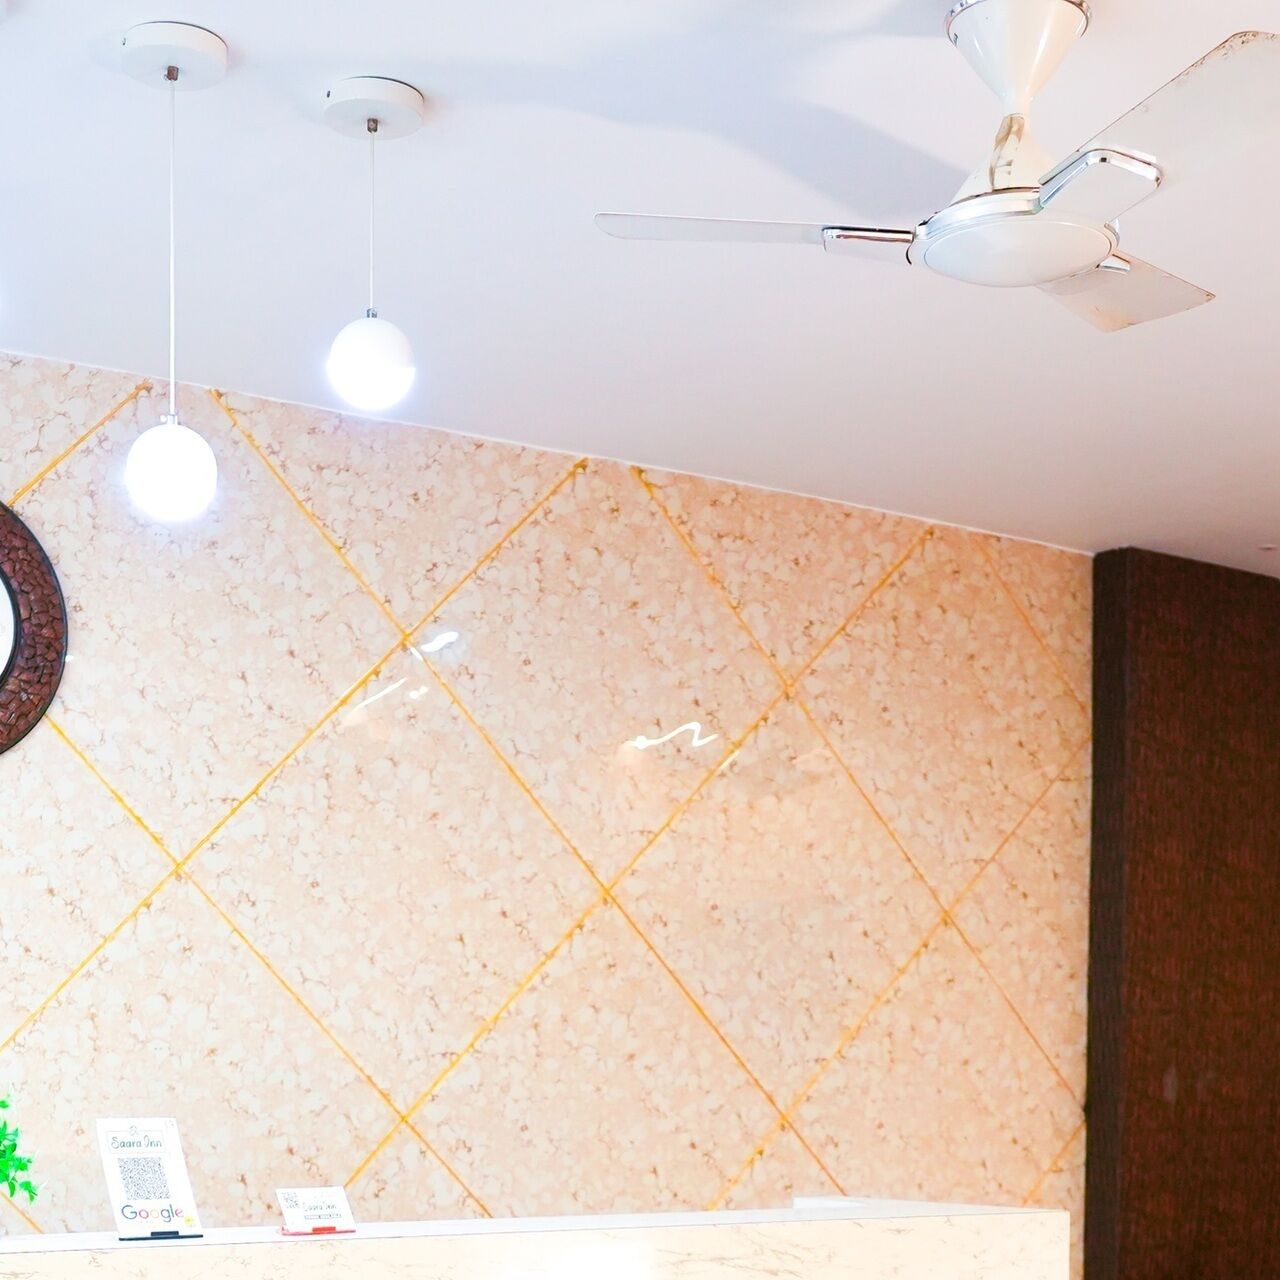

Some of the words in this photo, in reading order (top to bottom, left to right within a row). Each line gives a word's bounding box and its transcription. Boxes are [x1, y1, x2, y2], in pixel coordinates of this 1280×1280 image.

[111, 1136, 142, 1149] Saara
[143, 1134, 162, 1148] Inn
[121, 1203, 184, 1223] Google
